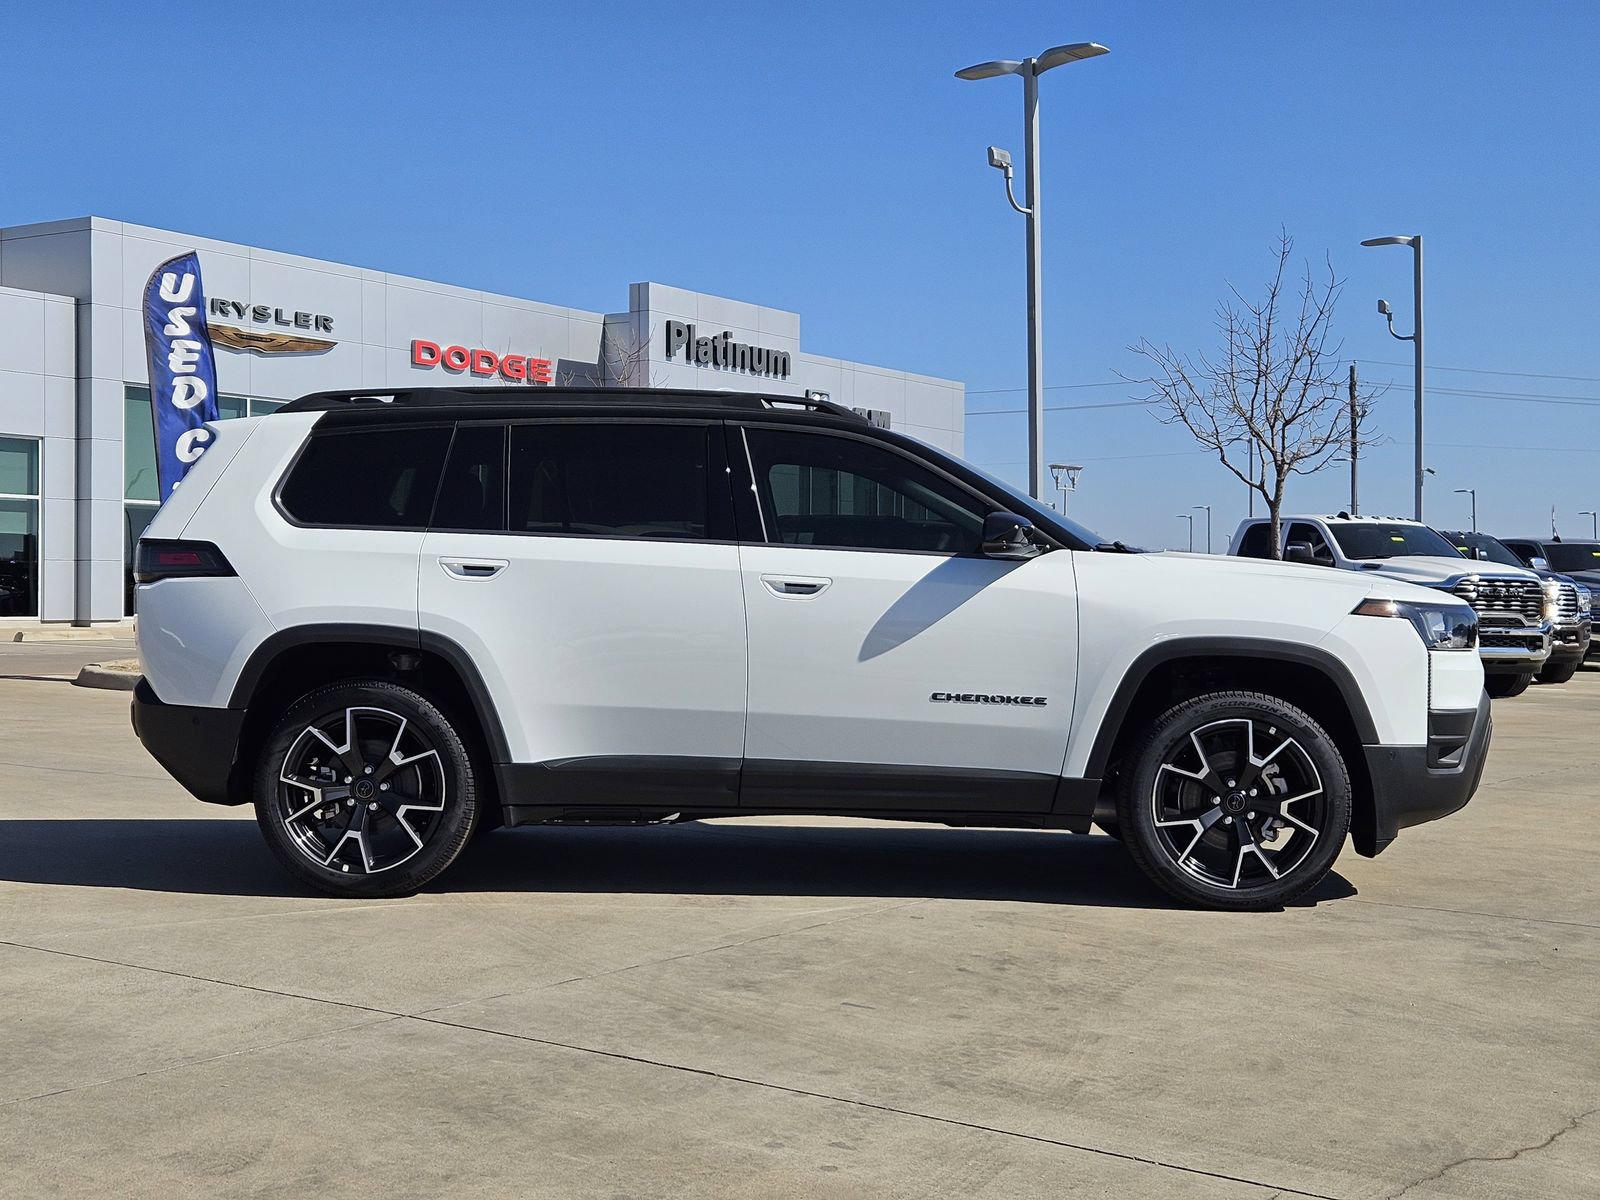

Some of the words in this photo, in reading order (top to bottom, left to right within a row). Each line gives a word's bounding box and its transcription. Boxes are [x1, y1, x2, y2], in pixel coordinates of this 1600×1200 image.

[203, 296, 334, 333] RYSLER
[159, 272, 208, 409] USED
[665, 320, 791, 380] Platinum
[411, 339, 552, 385] DODGE
[841, 406, 892, 430] AM
[931, 692, 1048, 706] CHEROKEE
[1210, 700, 1279, 714] SCORPION
